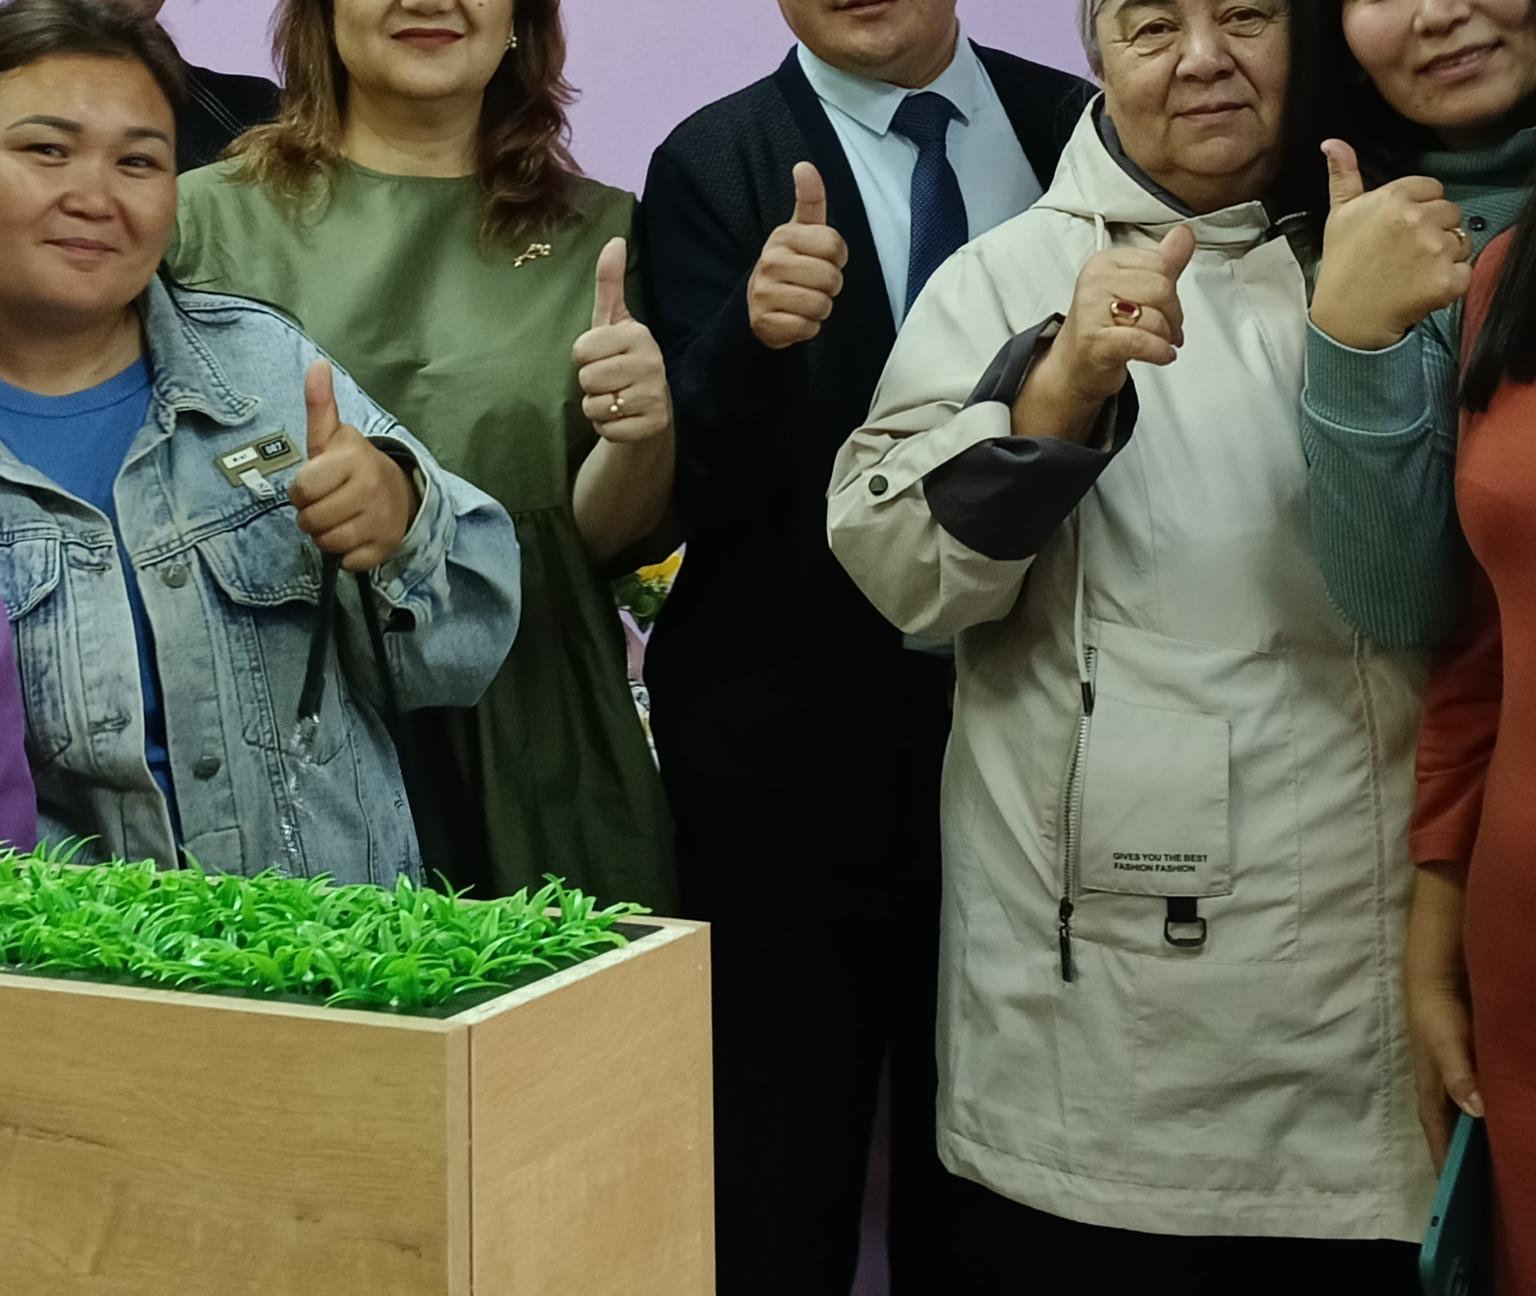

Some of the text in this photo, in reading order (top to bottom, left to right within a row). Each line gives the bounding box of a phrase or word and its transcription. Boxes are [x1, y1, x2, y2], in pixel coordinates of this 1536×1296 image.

[1112, 852, 1208, 863] GIVES YOU THE BEST
[1113, 862, 1196, 873] FASHION FASHION
